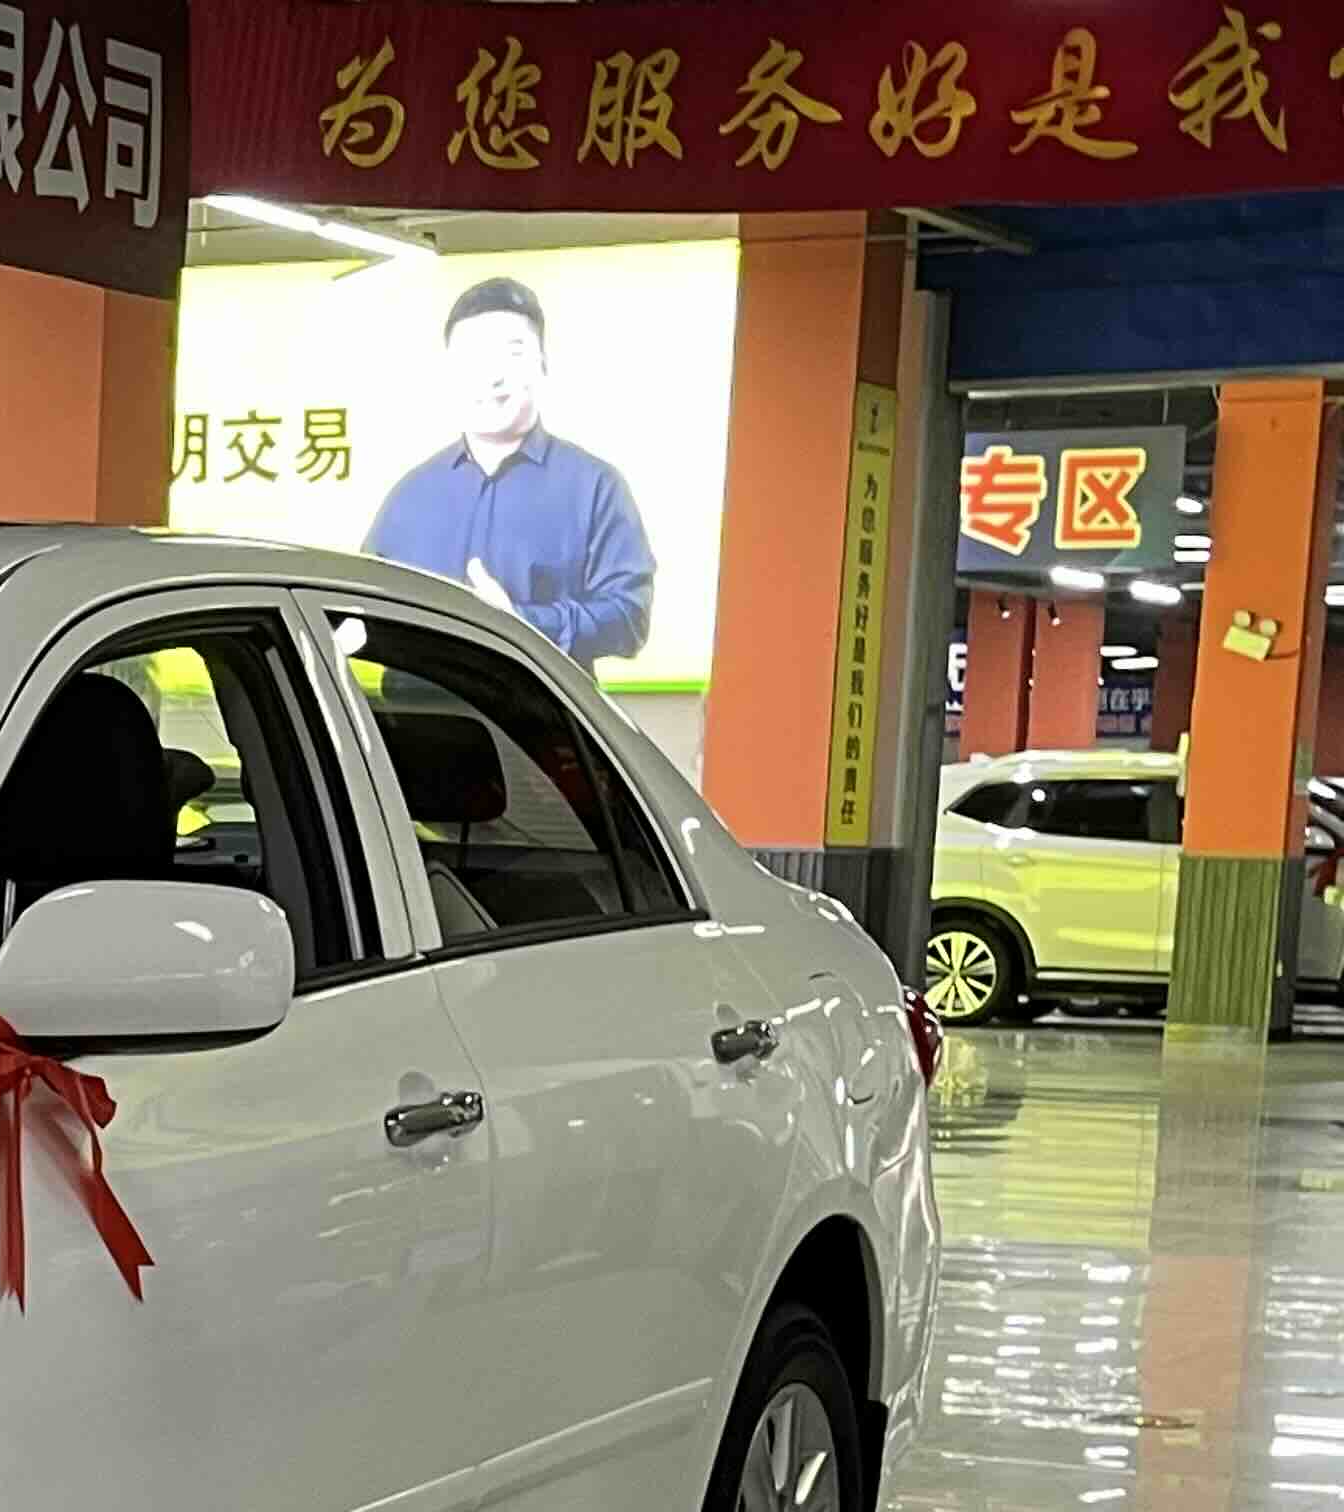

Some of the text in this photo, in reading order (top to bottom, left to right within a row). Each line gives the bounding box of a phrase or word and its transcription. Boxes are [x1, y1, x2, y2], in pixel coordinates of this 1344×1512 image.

[319, 4, 1344, 170] 为您服务好是我
[961, 445, 1147, 556] 专区
